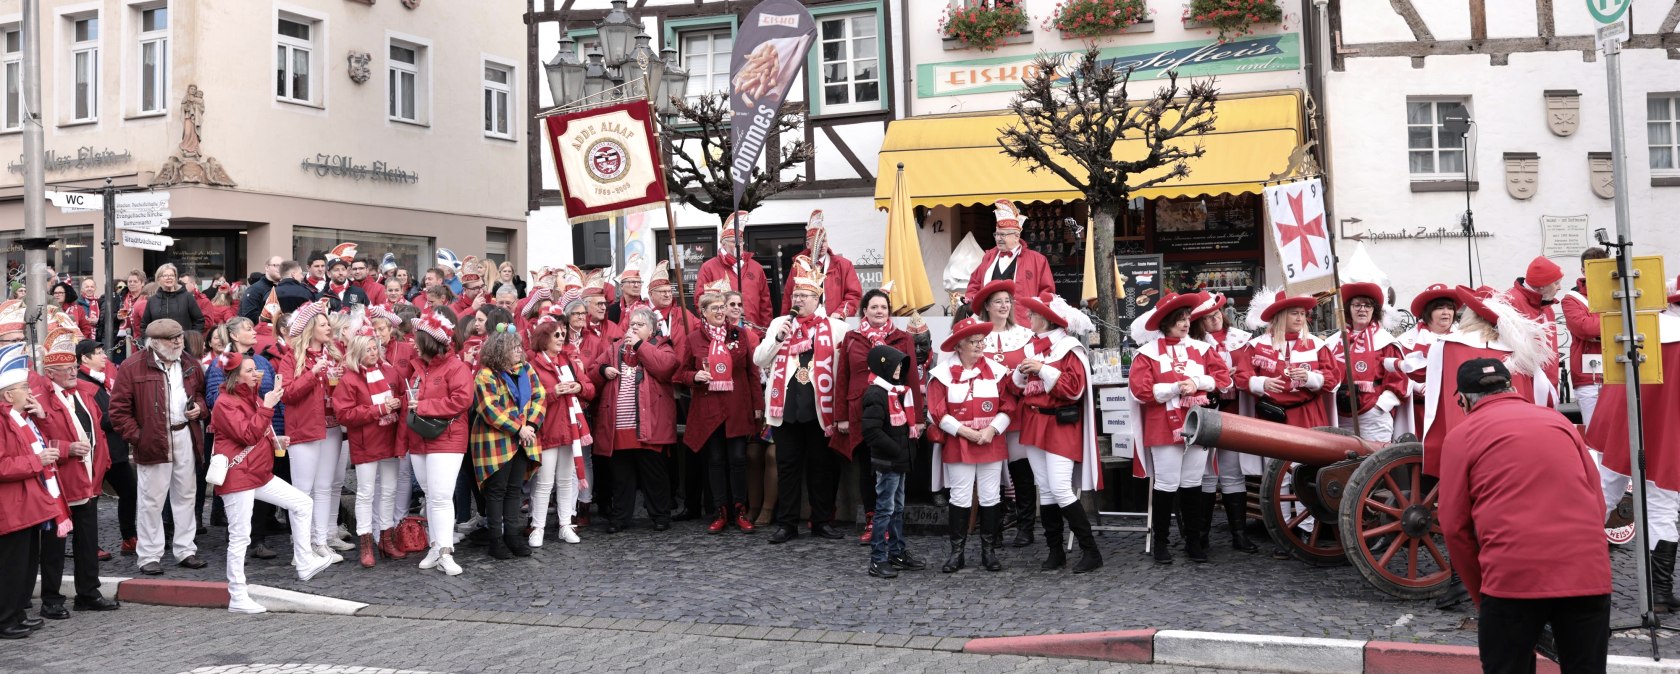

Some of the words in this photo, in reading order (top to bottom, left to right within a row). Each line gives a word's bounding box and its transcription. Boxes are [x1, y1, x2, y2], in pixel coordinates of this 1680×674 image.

[1113, 38, 1275, 78] Softeis
[944, 64, 1041, 85] EISKO
[571, 125, 596, 151] ADDE
[601, 122, 634, 139] ALAAF
[732, 104, 775, 184] Pommes
[65, 194, 84, 206] WC
[1310, 184, 1316, 199] 9
[932, 220, 944, 234] 12
[1287, 263, 1295, 279] 5
[1324, 254, 1330, 270] 9
[816, 355, 834, 414] YOU
